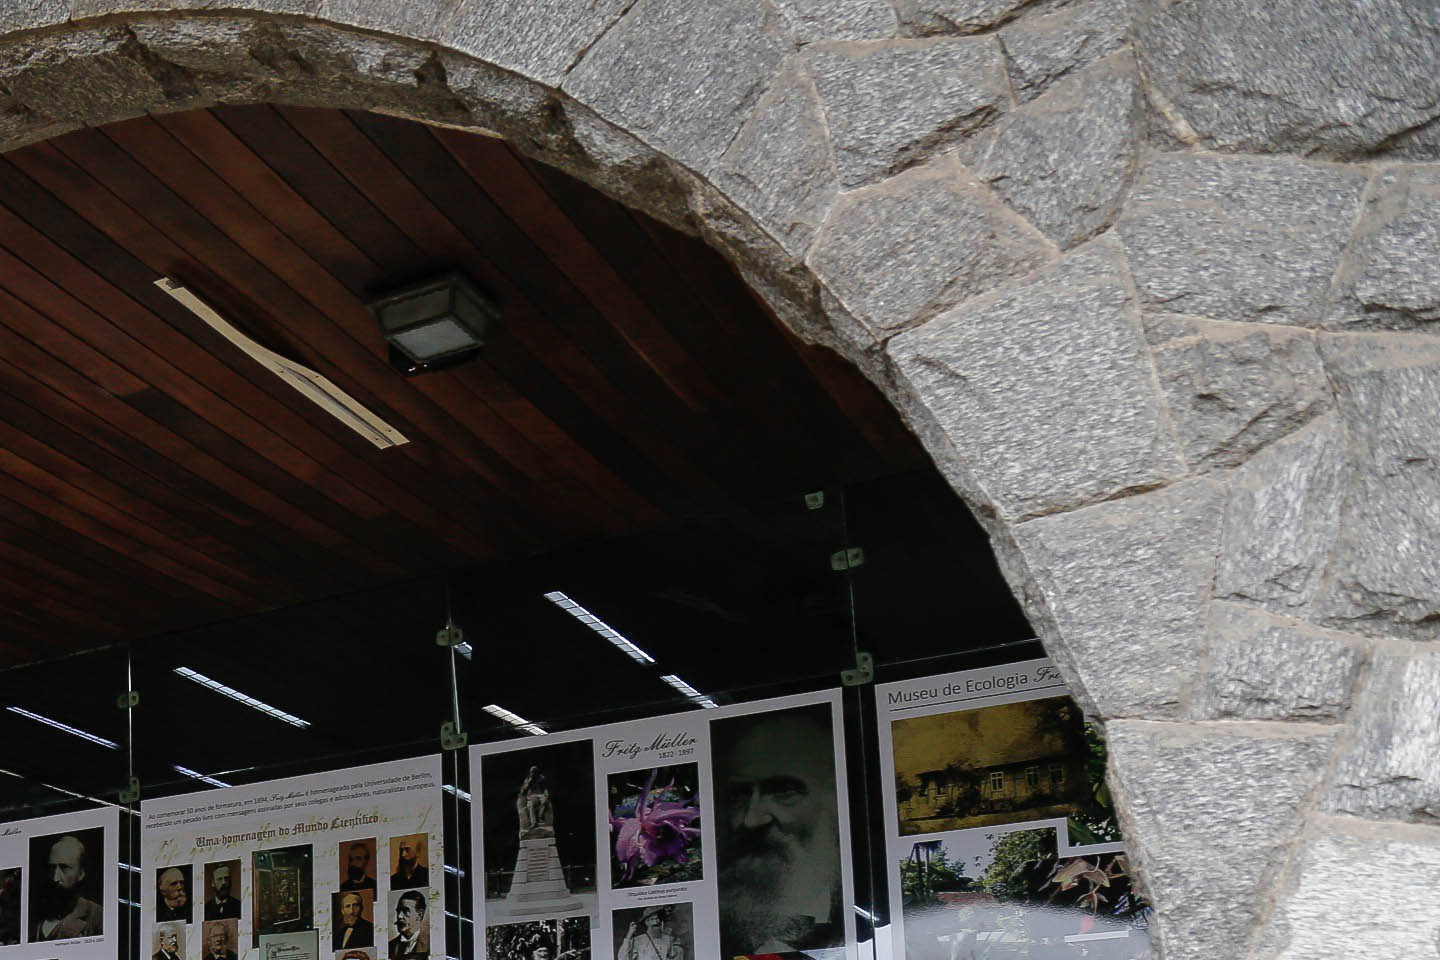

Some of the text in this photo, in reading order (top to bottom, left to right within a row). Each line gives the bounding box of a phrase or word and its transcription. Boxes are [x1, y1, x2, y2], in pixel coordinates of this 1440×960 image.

[888, 666, 1063, 705] Museu de Ecologia Fri
[602, 731, 697, 760] Fritz Müller
[658, 751, 674, 759] 1822
[678, 747, 694, 756] 1897
[146, 821, 173, 829] recebendo
[183, 816, 202, 825] pesado
[226, 808, 257, 817] mensagens
[257, 804, 283, 813] assinadas
[308, 798, 329, 806] colegas
[334, 792, 372, 802] admiradores,
[372, 786, 406, 796] naturalistas
[156, 810, 186, 819] comemorar
[215, 802, 244, 810] formatura,
[310, 785, 350, 796] homenageado
[364, 777, 402, 788] Universidade
[411, 772, 433, 781] Berlim,
[196, 812, 379, 848] Uma homenagem do Mundo Científico
